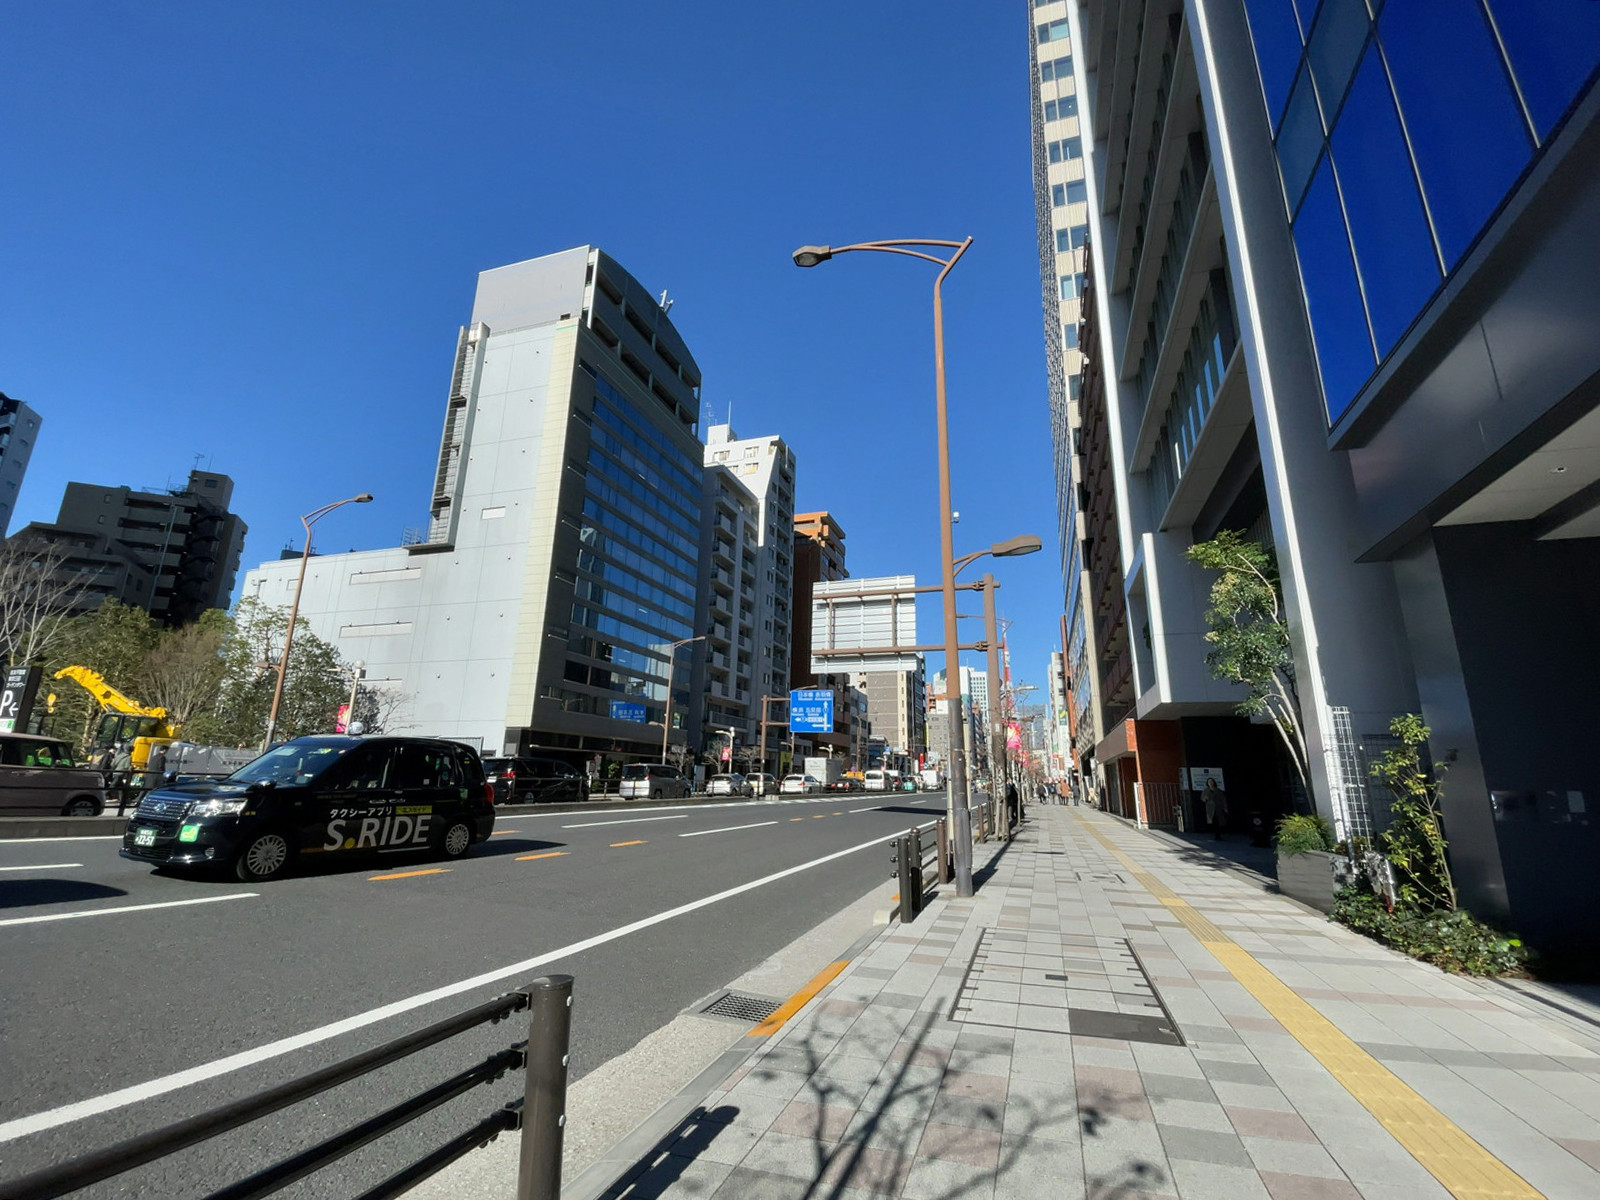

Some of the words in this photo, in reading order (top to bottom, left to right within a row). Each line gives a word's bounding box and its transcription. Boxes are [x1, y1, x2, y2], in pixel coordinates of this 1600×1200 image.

[0, 690, 13, 716] P
[330, 806, 392, 818] タクシーアプリ
[323, 815, 432, 851] S.RIDE
